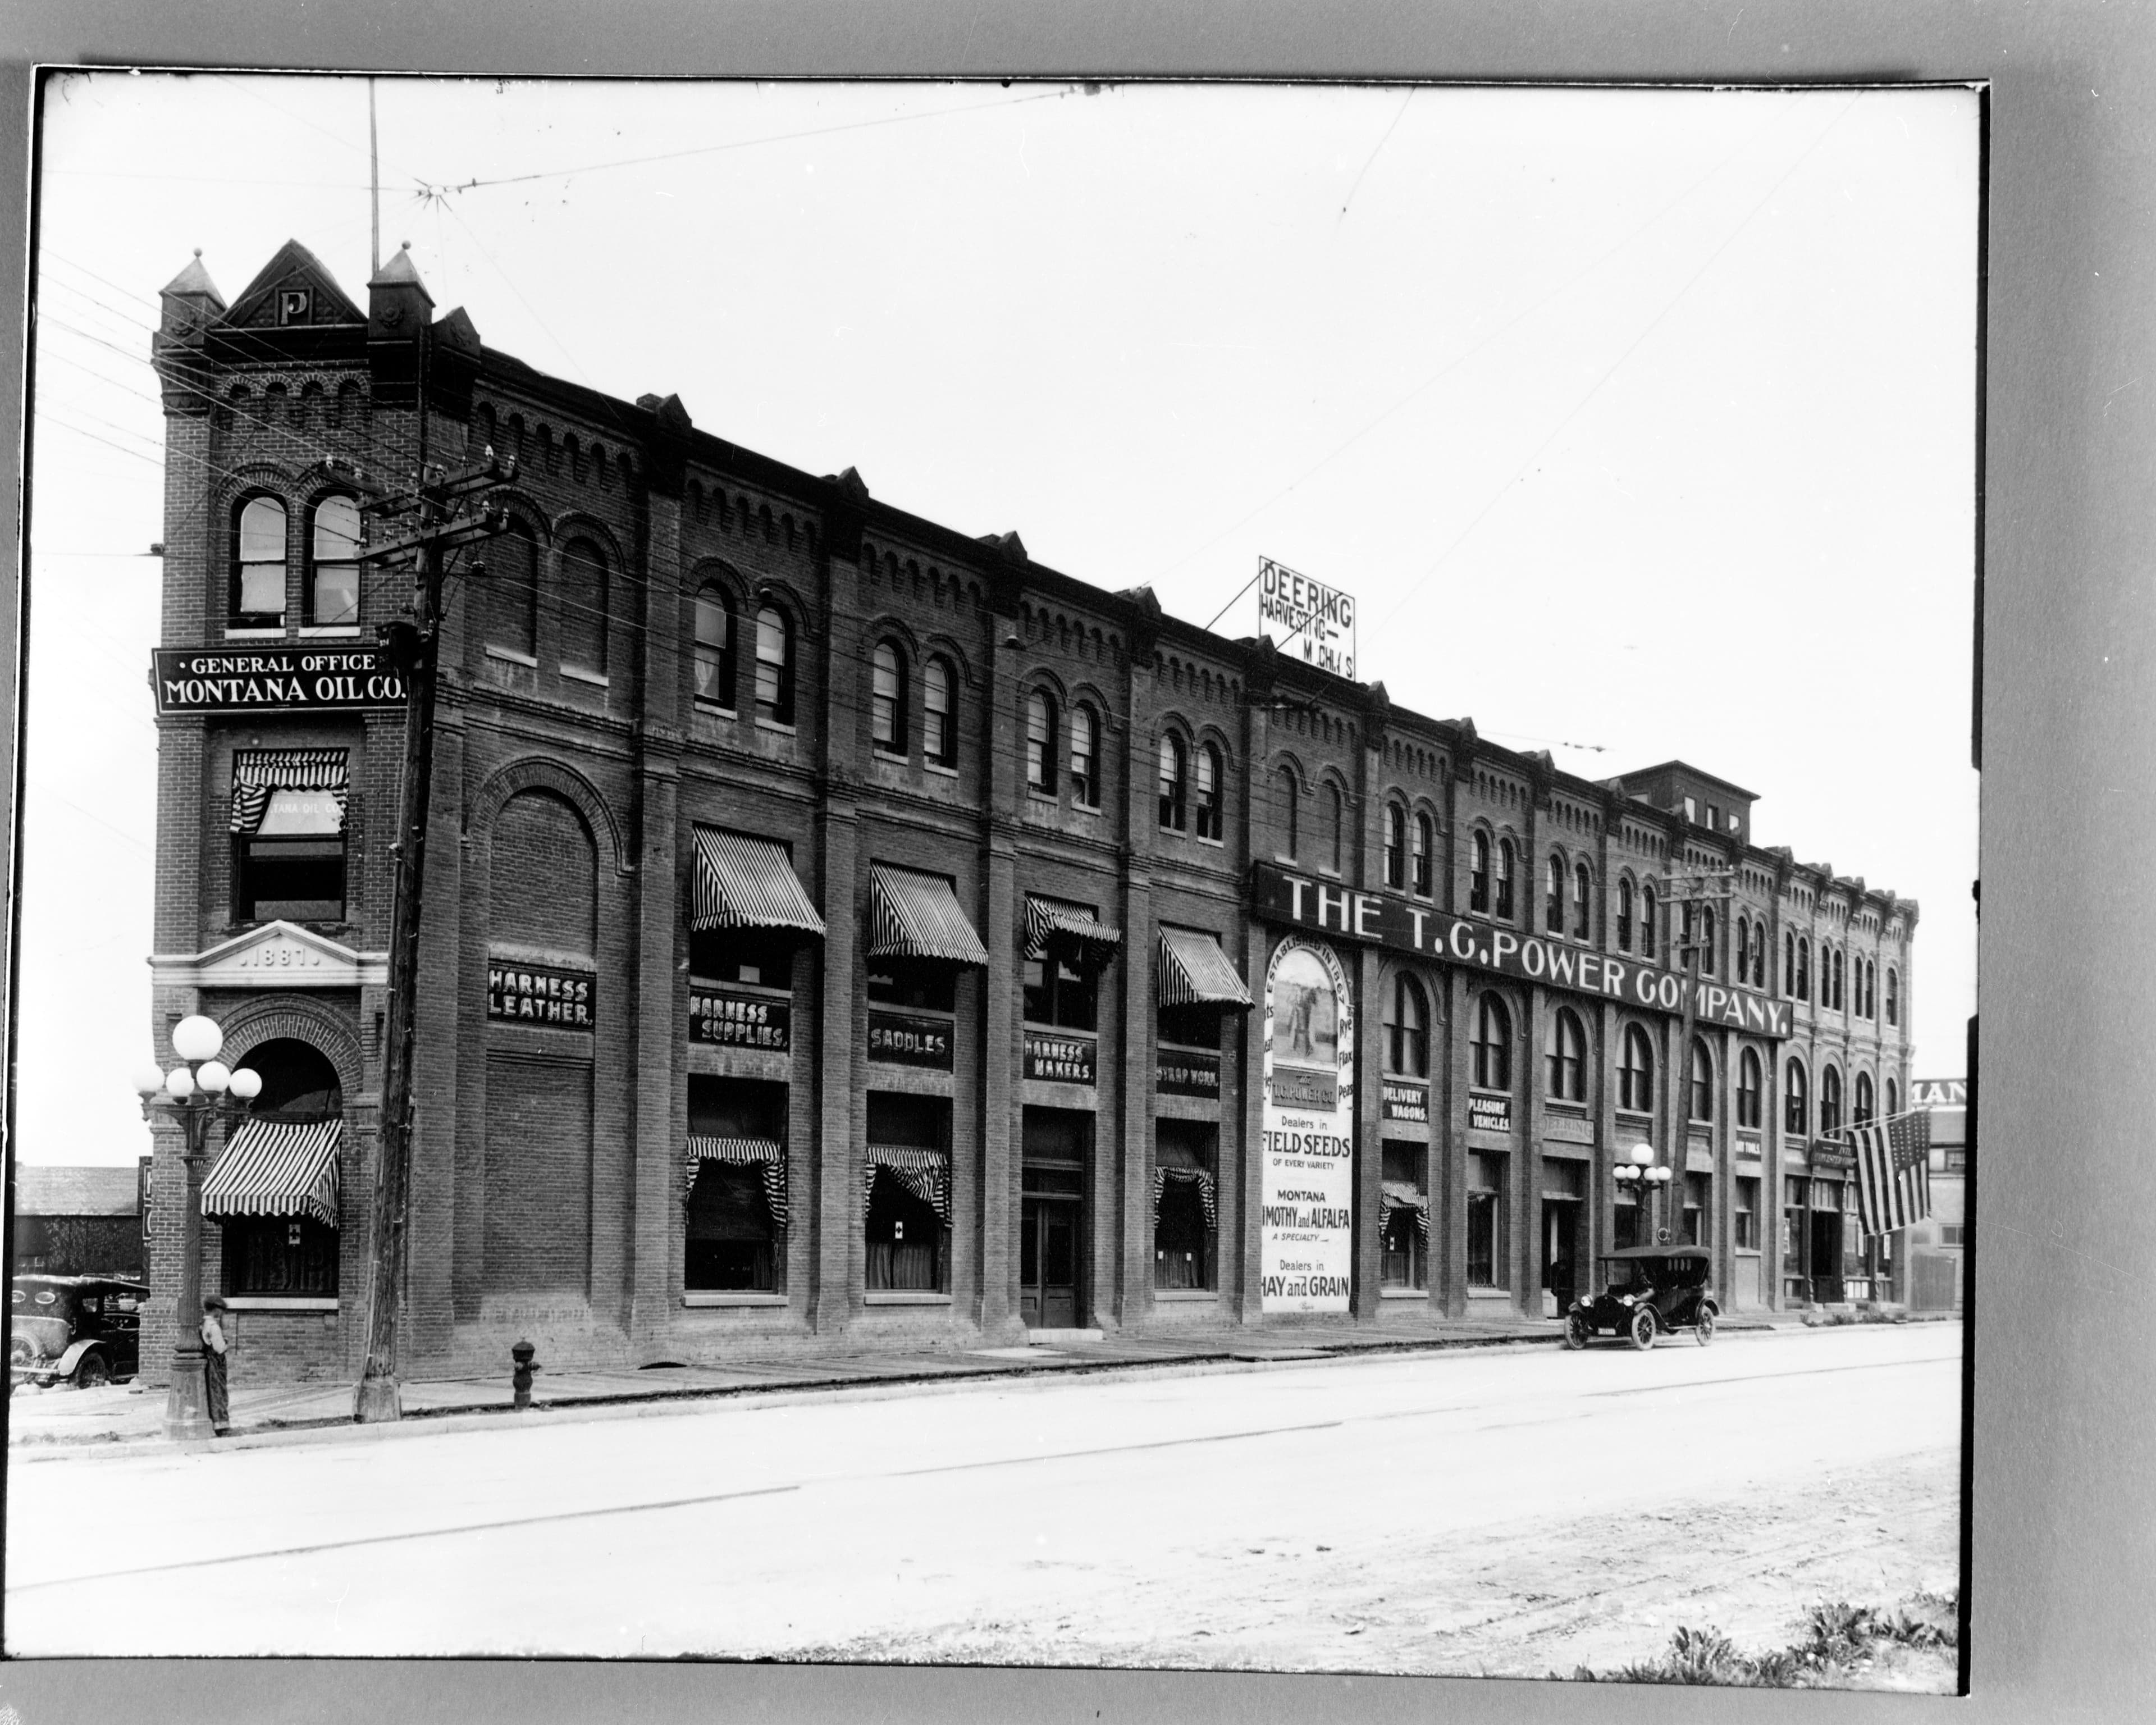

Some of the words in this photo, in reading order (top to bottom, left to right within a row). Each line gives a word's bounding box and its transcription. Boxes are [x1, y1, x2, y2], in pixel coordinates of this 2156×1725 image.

[281, 292, 307, 325] P
[1264, 562, 1352, 628] DEERING
[191, 656, 294, 674] GENERAL
[301, 655, 376, 672] OFFICE
[165, 676, 309, 704] MONTANA
[316, 677, 364, 701] OIL
[367, 676, 407, 700] CO.
[303, 804, 319, 814] OIL
[1283, 875, 1382, 939] THE
[1267, 934, 1321, 993] ESTABLISHED
[1322, 947, 1332, 965] IN
[1331, 965, 1345, 1005] 1867
[488, 970, 588, 1002] HARNESS
[690, 996, 768, 1024] HARNESS
[1340, 1018, 1353, 1039] Rye
[871, 1028, 945, 1054] SADDLES
[1024, 1039, 1083, 1062] HARNESS
[1383, 1086, 1423, 1105] DELIVERY
[1468, 1098, 1506, 1115] PLEASURE
[1281, 1115, 1314, 1129] Dealers
[1319, 1119, 1327, 1130] in
[1304, 1134, 1350, 1158] SEEDS
[1272, 1158, 1282, 1167] OF
[1285, 1159, 1305, 1169] EVERY
[1307, 1161, 1335, 1170] VARIETY
[1277, 1189, 1326, 1203] MONTANA
[1298, 1211, 1310, 1228] and
[1311, 1208, 1350, 1229] ALFALFA
[1281, 1233, 1319, 1242] SPECIALTY
[1280, 1259, 1312, 1272] Dealers
[1316, 1259, 1324, 1271] in
[1287, 1276, 1308, 1297] and
[1309, 1276, 1349, 1297] GRAIN
